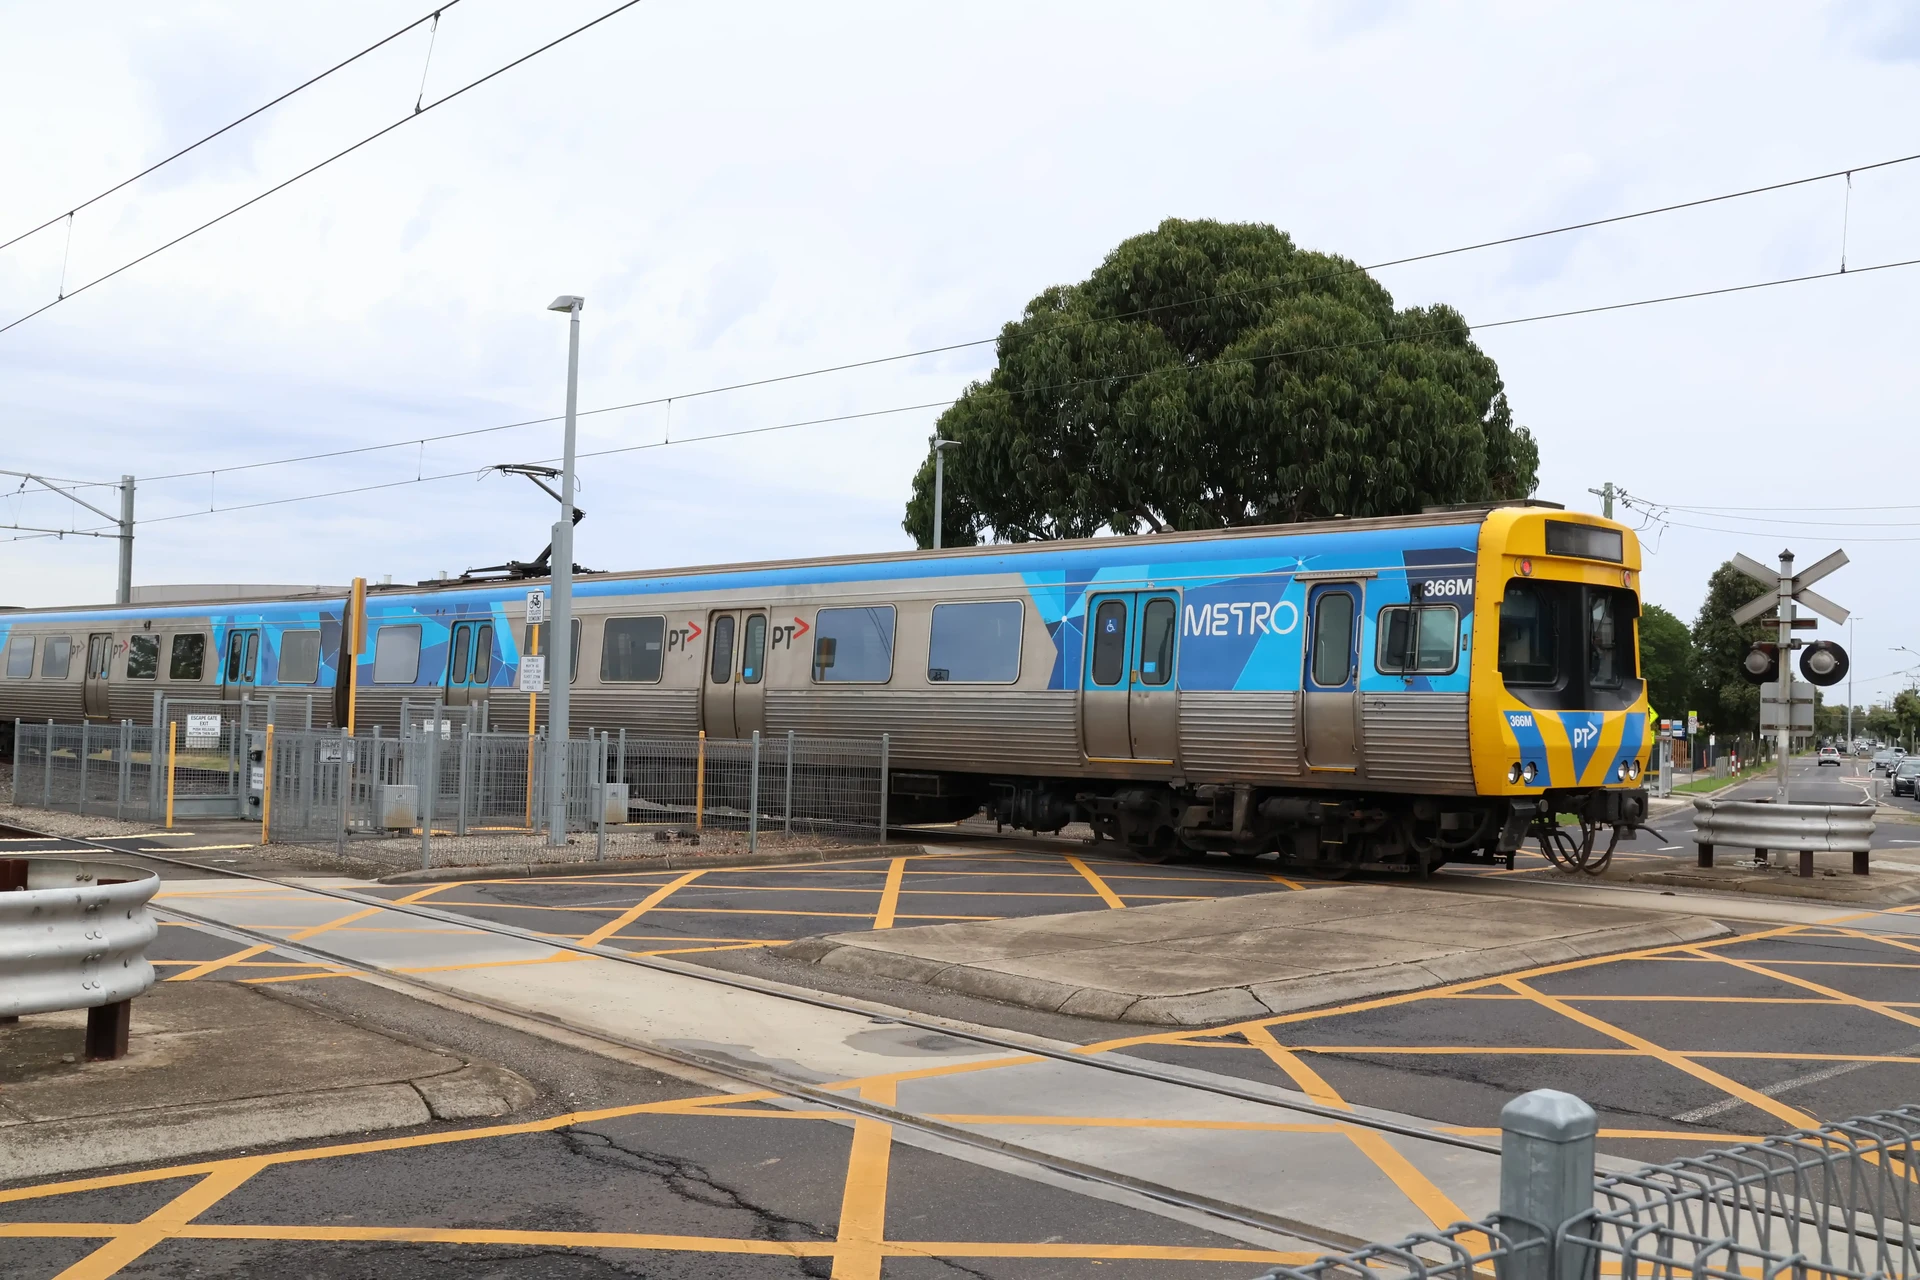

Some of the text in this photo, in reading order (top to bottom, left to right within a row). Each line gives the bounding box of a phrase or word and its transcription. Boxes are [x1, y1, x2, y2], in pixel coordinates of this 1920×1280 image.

[1424, 578, 1473, 597] 366M
[1183, 600, 1299, 637] METRO
[1509, 715, 1533, 727] 366M
